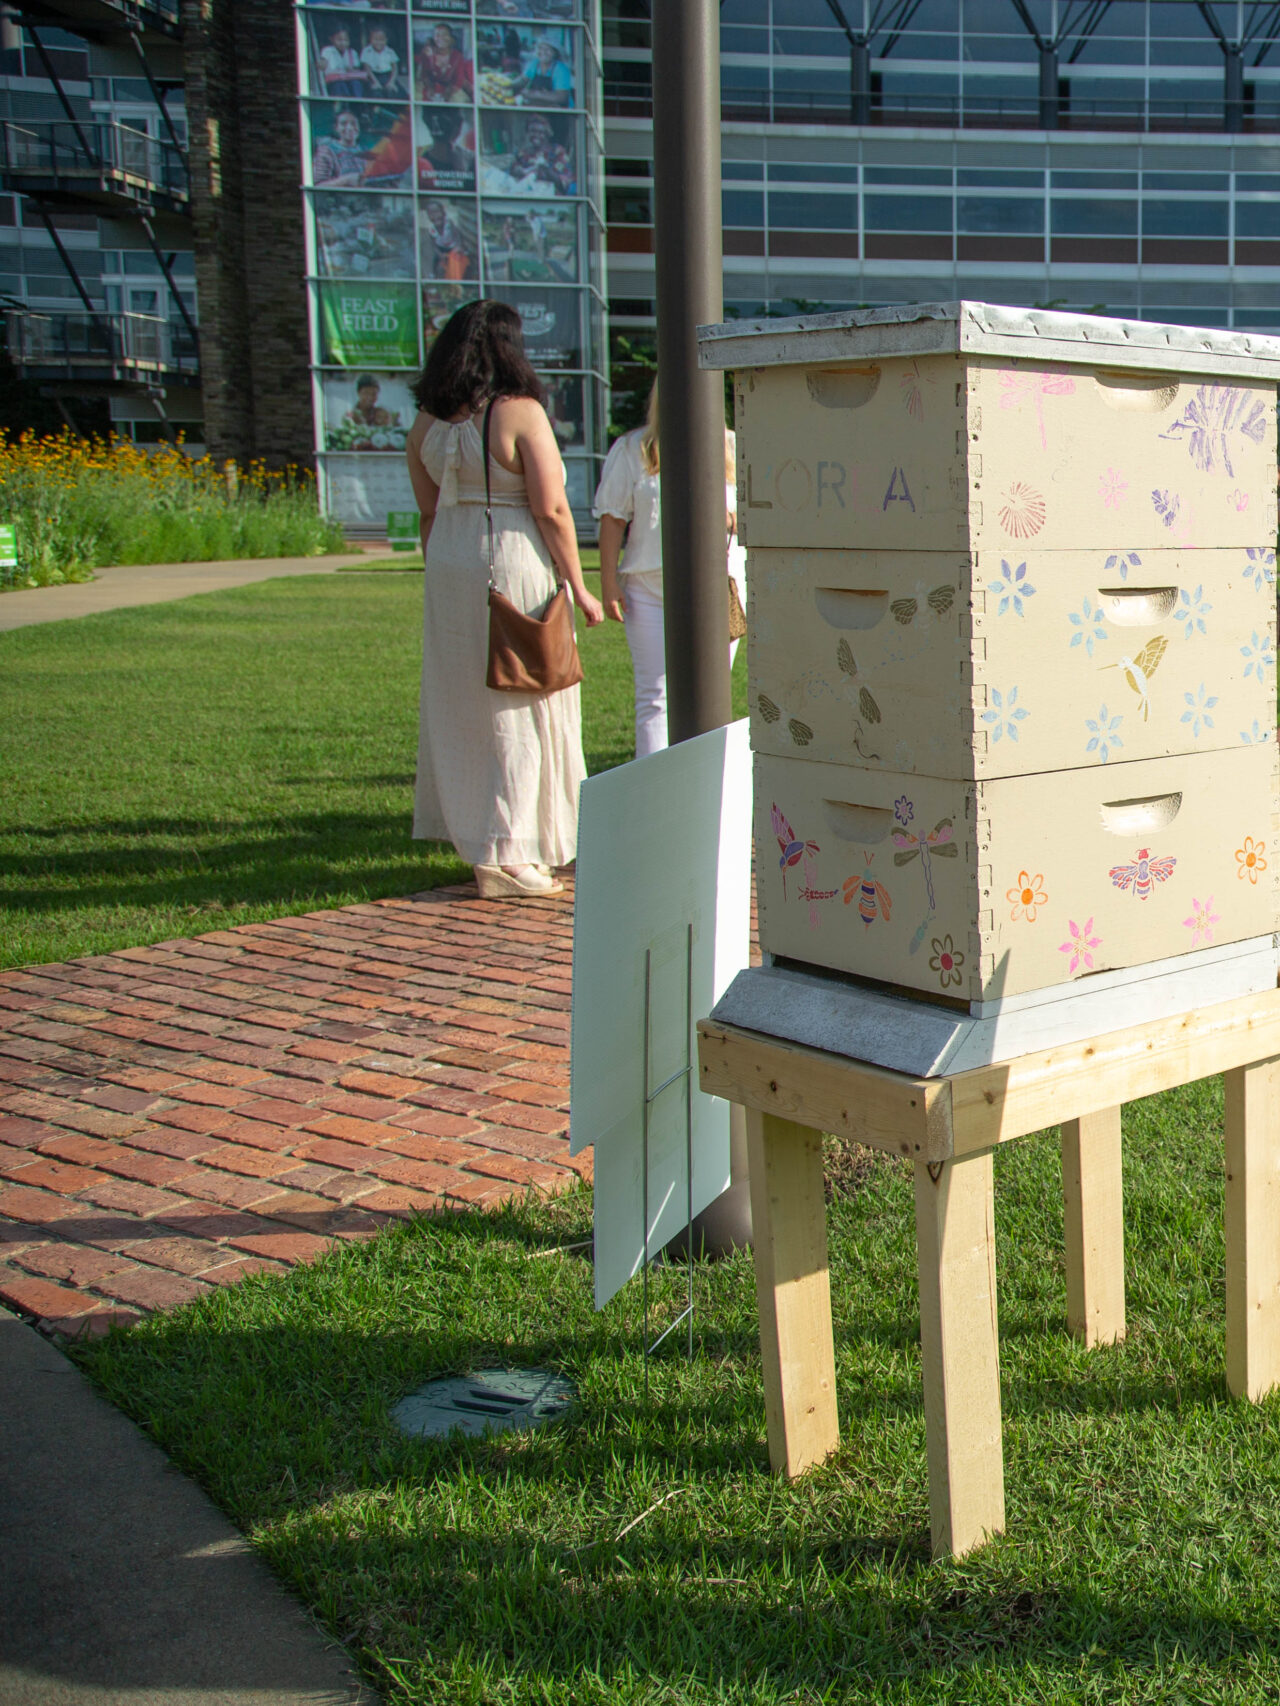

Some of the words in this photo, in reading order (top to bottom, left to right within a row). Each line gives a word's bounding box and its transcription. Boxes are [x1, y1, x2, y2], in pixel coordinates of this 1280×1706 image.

[433, 179, 464, 189] WOMEN
[340, 297, 398, 314] FEAST
[342, 313, 399, 332] FIELD
